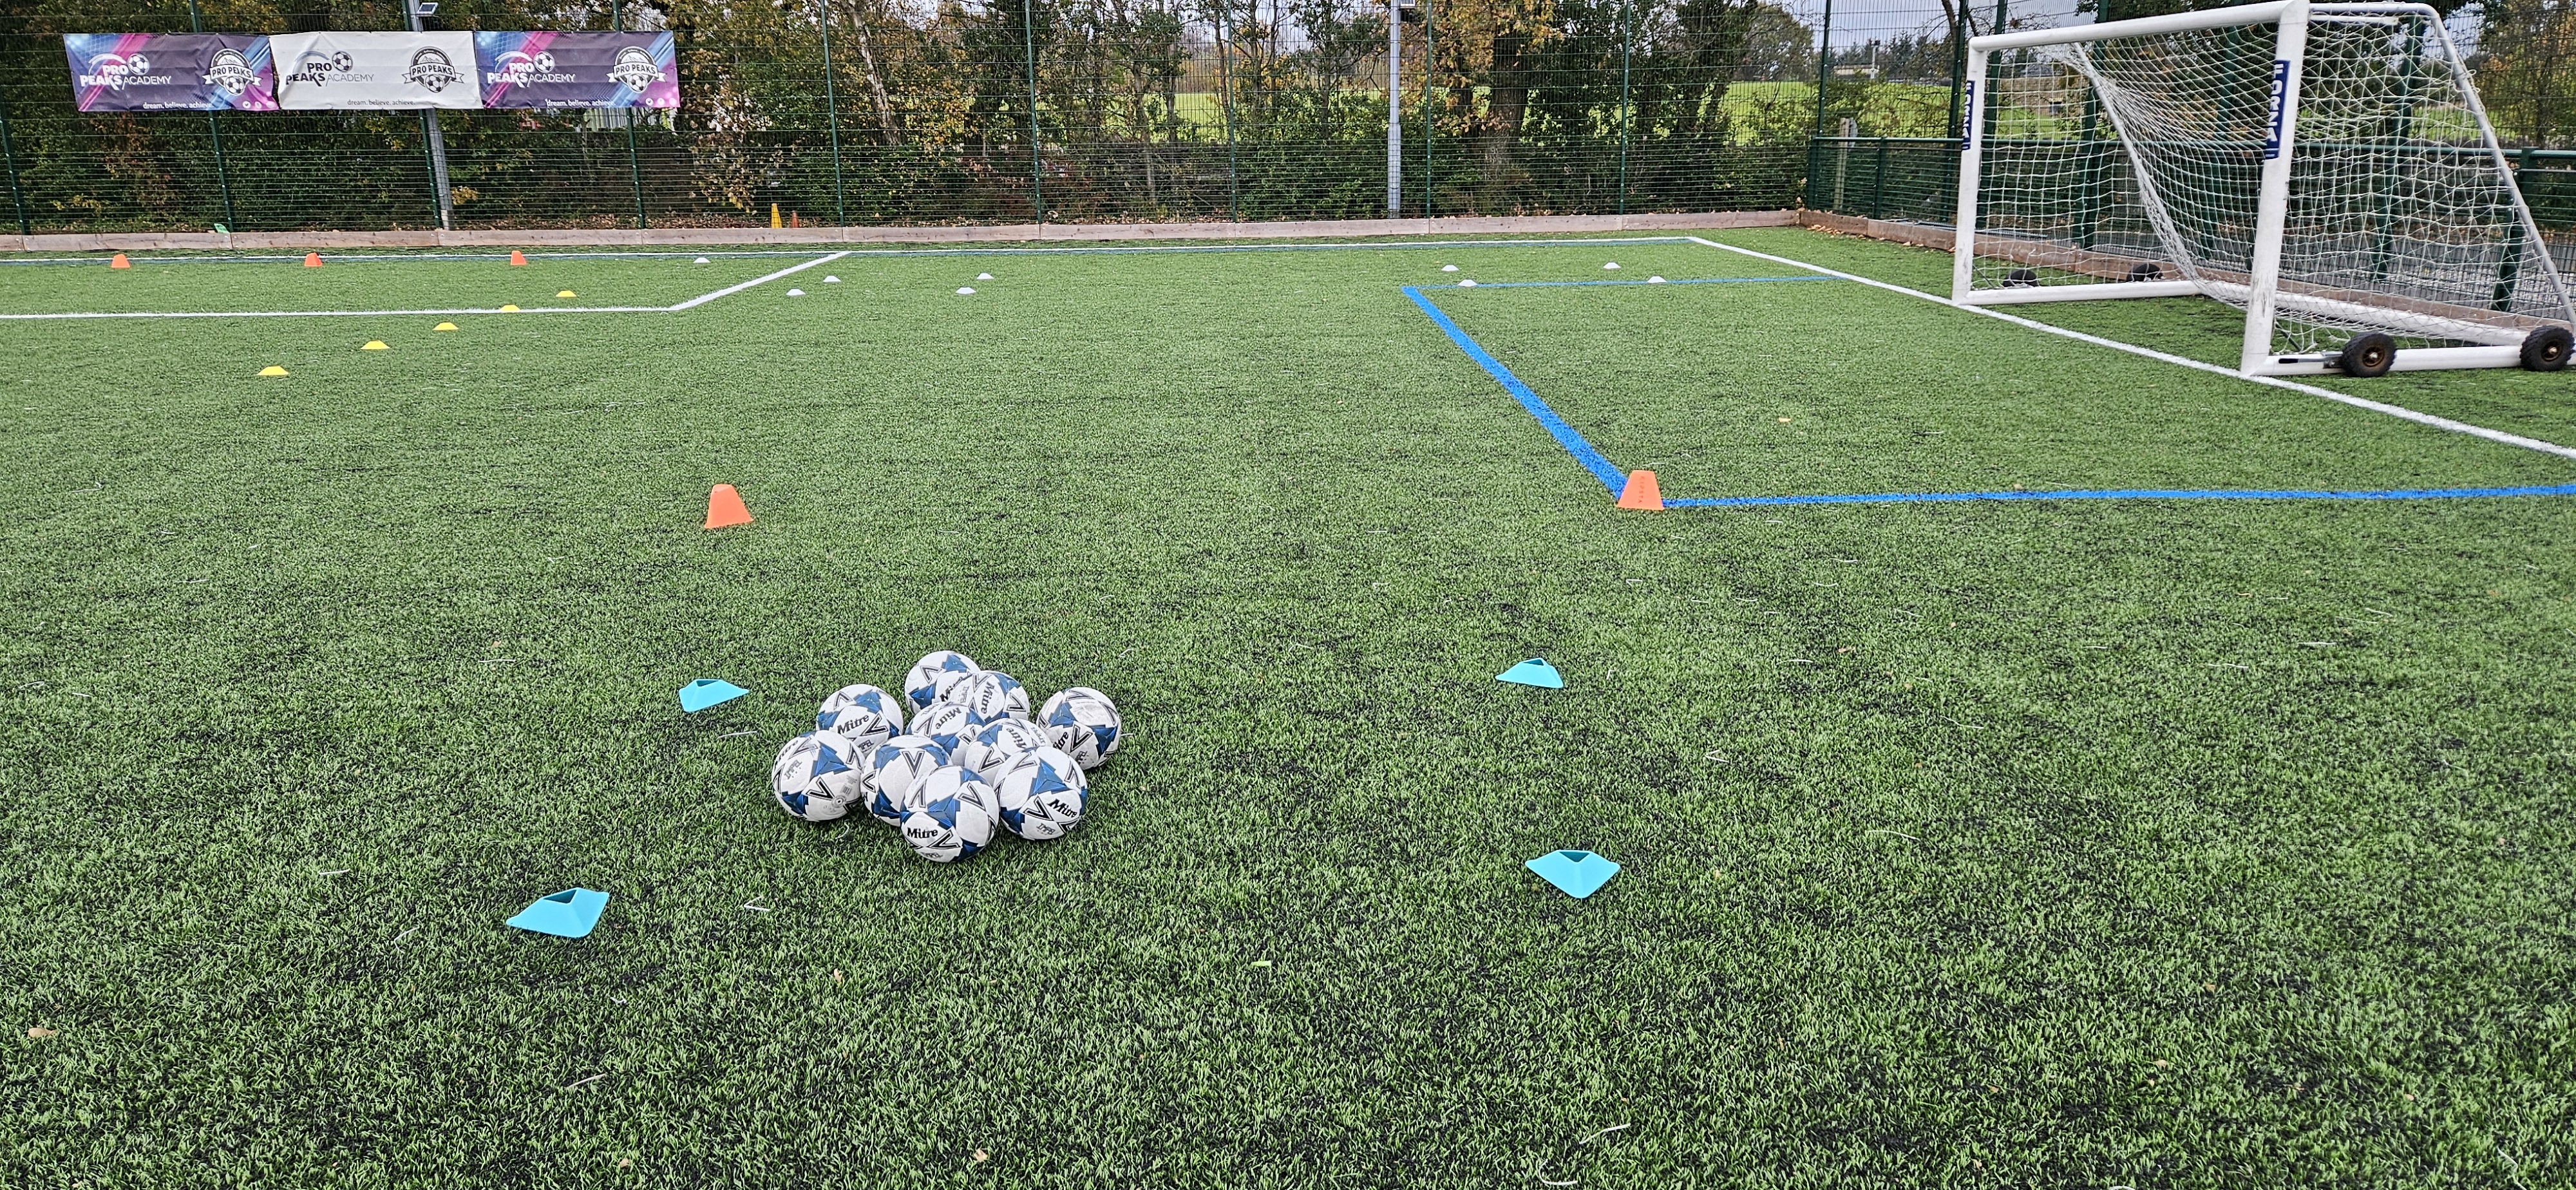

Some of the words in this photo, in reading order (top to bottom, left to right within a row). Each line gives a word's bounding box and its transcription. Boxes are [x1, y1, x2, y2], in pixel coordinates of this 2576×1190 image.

[102, 64, 129, 75] PRO
[213, 66, 227, 77] PRO
[228, 66, 251, 78] PEAKS
[307, 62, 332, 73] PRO
[412, 66, 427, 75] PRO
[428, 64, 453, 75] PEAKS
[509, 62, 535, 73] PRO
[616, 65, 630, 75] PRO
[632, 64, 656, 75] PEAKS
[79, 75, 120, 90] PEAKS
[121, 75, 172, 90] ACADEMY
[286, 72, 326, 86] PEAKS
[326, 73, 374, 86] ACADEMY
[487, 72, 528, 88] PEAKS
[527, 73, 576, 88] ACADEMY
[2266, 64, 2284, 142] FORZA
[981, 681, 995, 714] Mitre
[837, 715, 869, 735] Mitre
[935, 707, 962, 730] Mitre
[1053, 732, 1069, 750] itre
[1046, 798, 1078, 818] Mitre
[907, 827, 938, 838] Mitre
